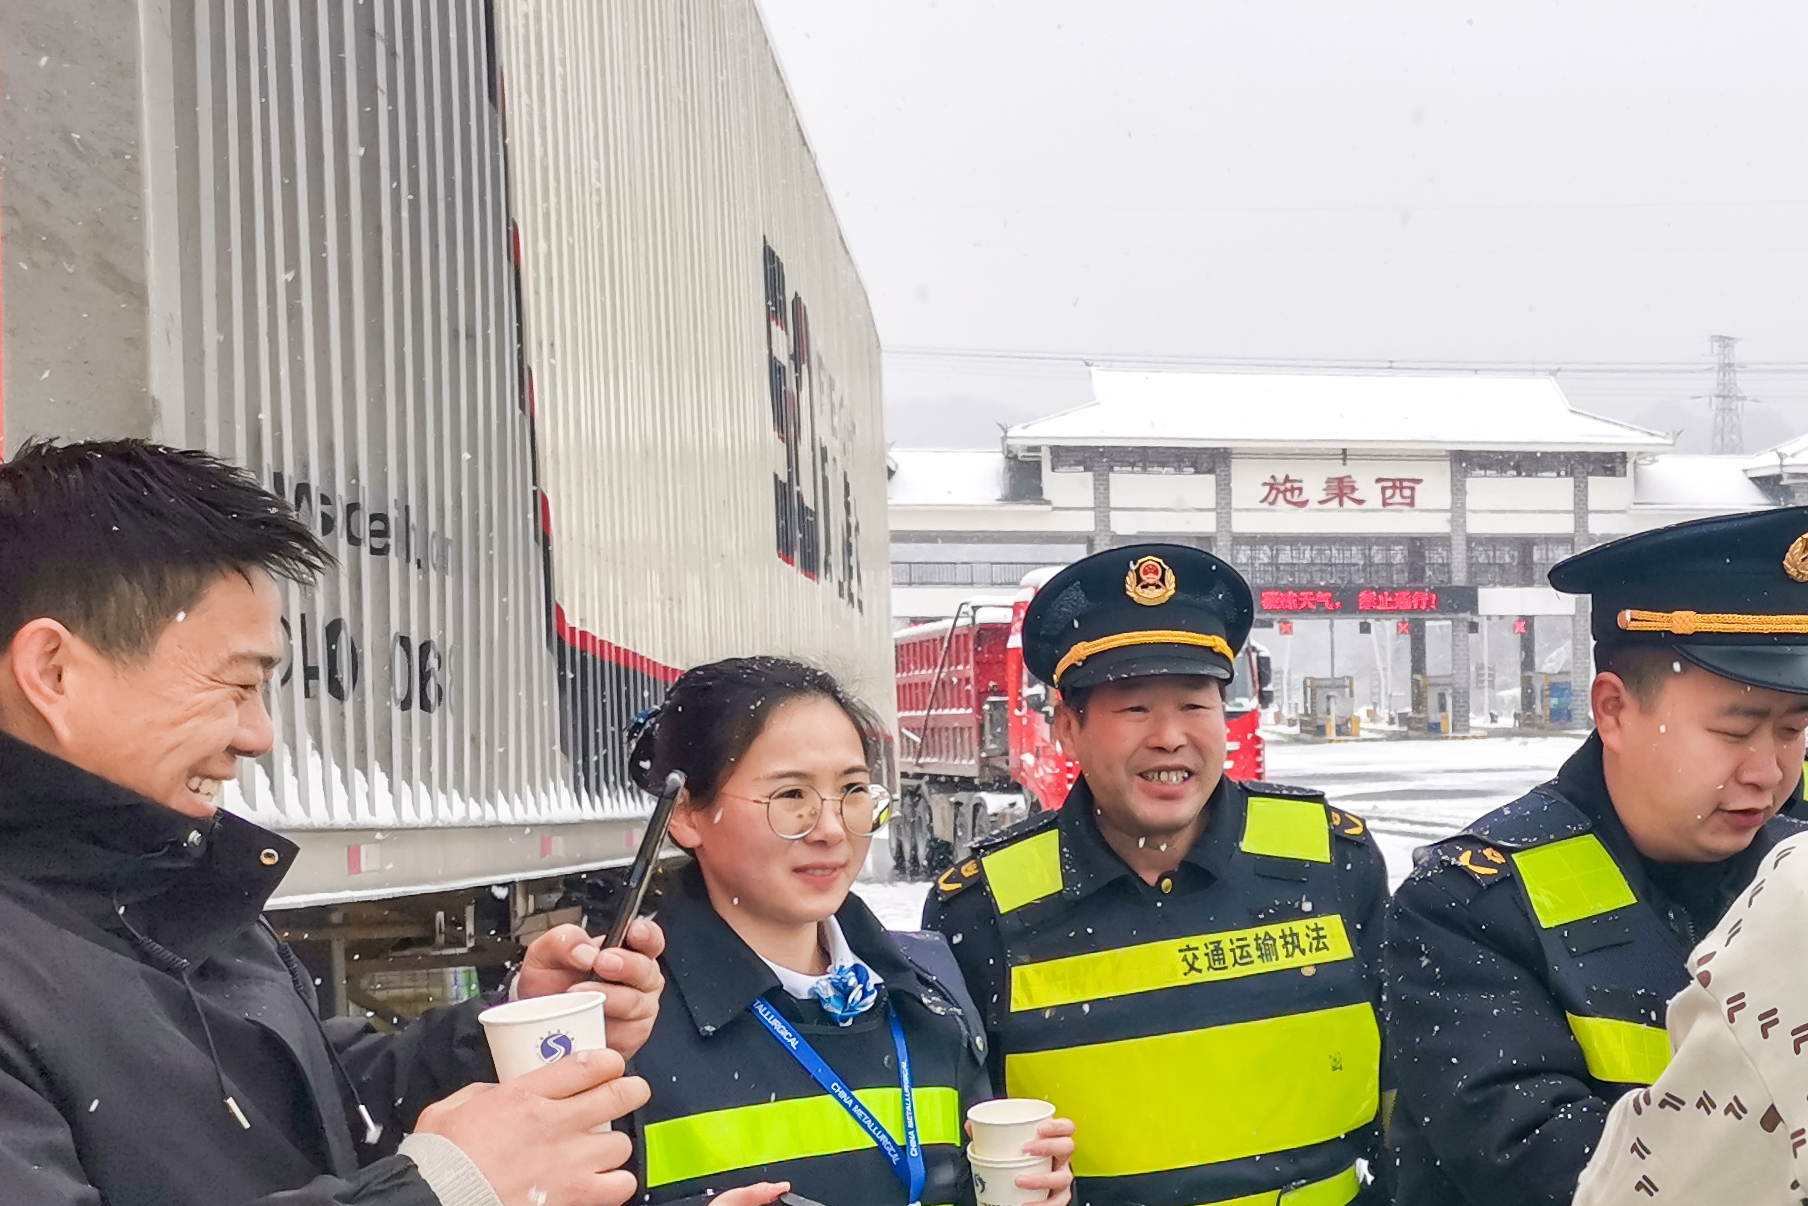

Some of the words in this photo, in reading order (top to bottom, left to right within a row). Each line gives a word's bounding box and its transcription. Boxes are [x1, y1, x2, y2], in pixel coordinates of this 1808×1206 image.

[1259, 474, 1424, 508] 施秉西
[1178, 922, 1330, 976] 交通运输执法
[830, 1082, 854, 1108] CHINA
[908, 1130, 918, 1157] CHINA
